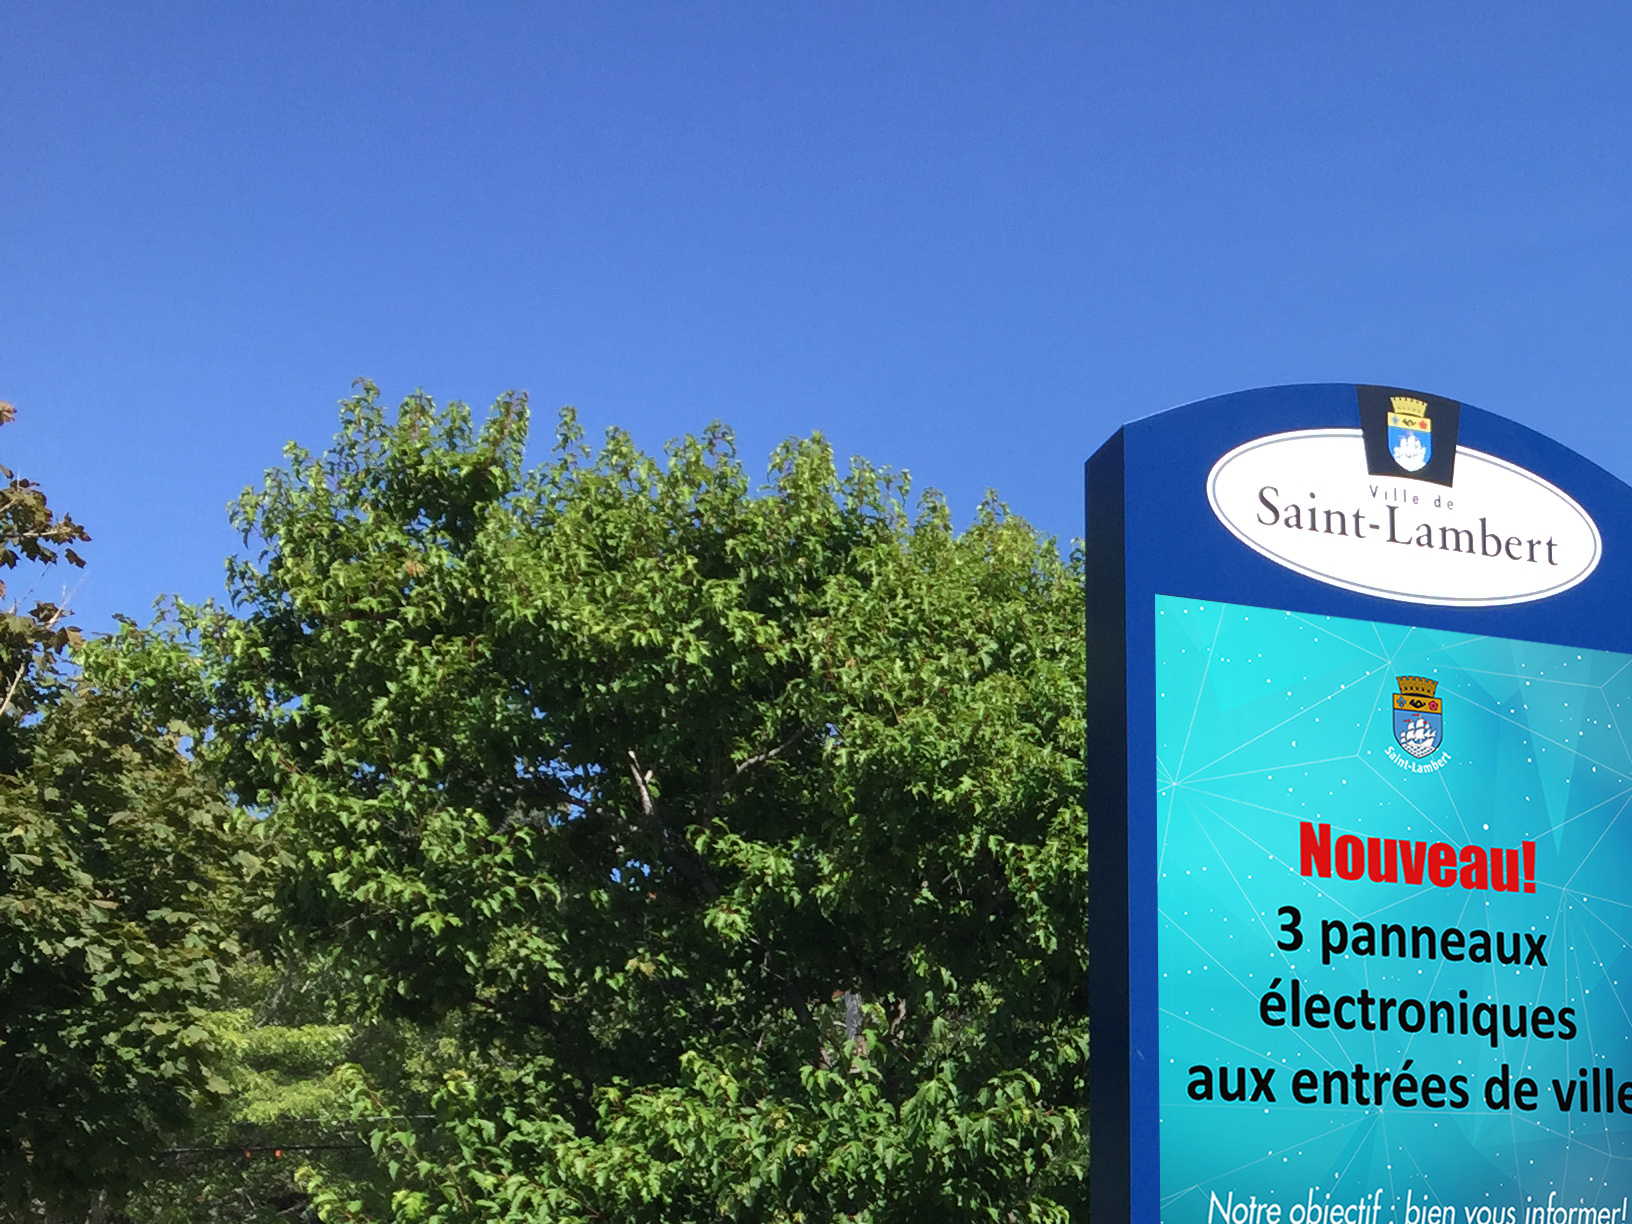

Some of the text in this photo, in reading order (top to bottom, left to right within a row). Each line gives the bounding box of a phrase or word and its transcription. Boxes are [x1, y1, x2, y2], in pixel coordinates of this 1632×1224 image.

[1256, 485, 1559, 566] Saint-Lambert
[1369, 484, 1454, 510] Ville de
[1384, 745, 1452, 774] Saint-Lambert
[1299, 821, 1536, 894] Nouveau!
[1277, 905, 1548, 967] 3 panneaux
[1259, 977, 1577, 1048] électroniques
[1187, 1065, 1276, 1102] aux
[1291, 1059, 1470, 1109] entrées
[1484, 1063, 1538, 1112] de
